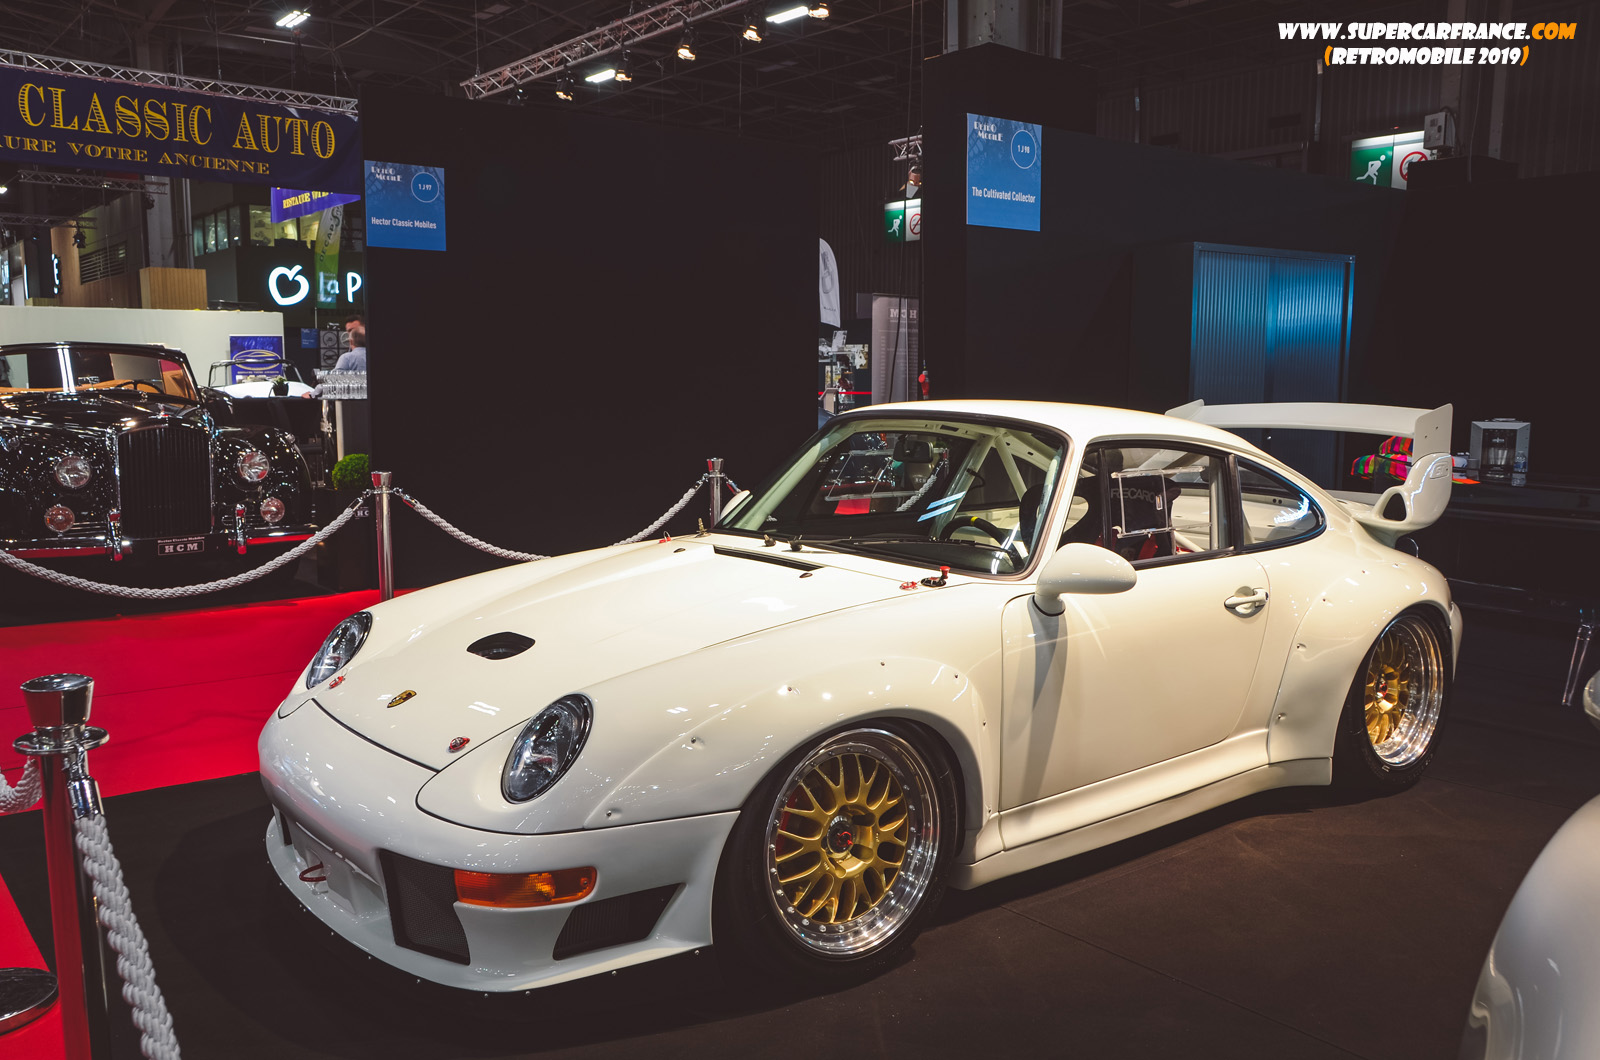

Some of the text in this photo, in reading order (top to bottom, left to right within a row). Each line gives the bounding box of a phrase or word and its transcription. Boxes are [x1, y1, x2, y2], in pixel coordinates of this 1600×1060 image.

[17, 82, 337, 160] CLASSIC AUTO
[0, 135, 271, 175] URE VOTRE ANCIENNE
[971, 186, 1036, 203] The Cultivated Collector
[371, 216, 437, 229] Hector Classic Mobiles
[1110, 488, 1155, 503] RECARO
